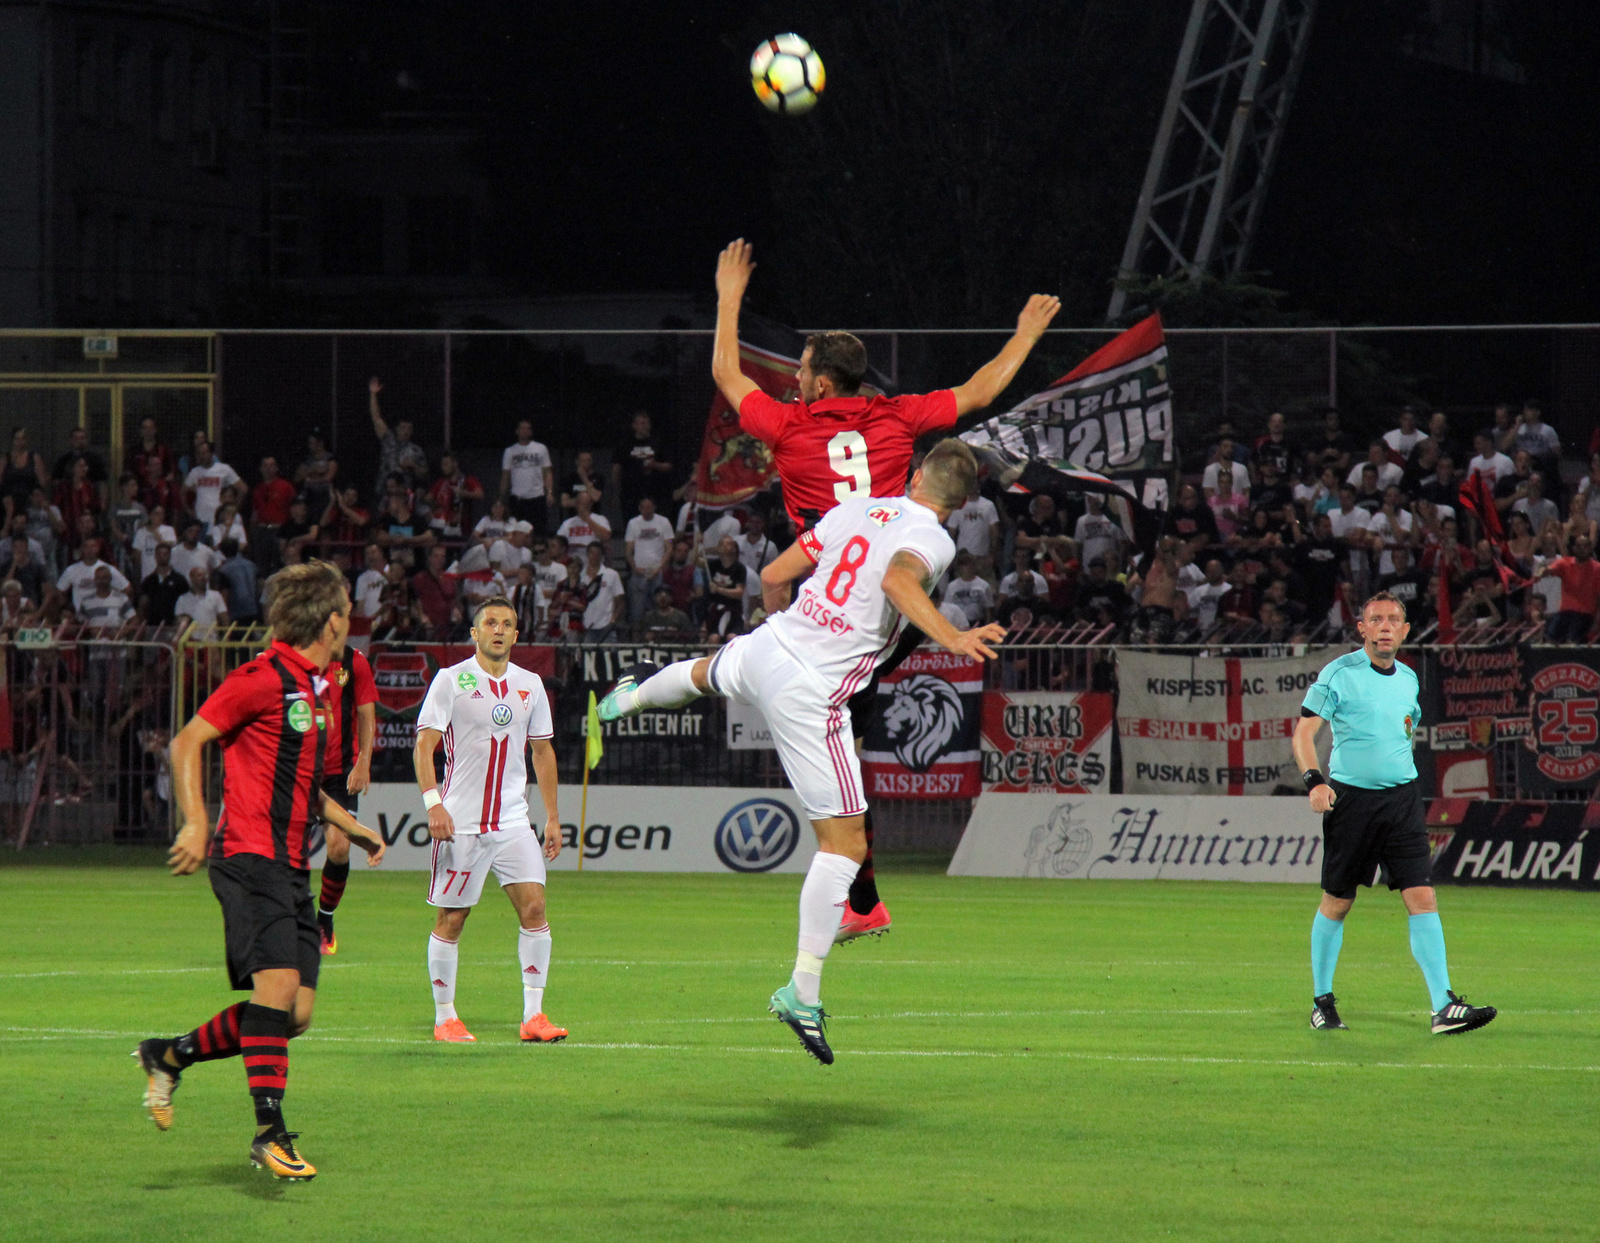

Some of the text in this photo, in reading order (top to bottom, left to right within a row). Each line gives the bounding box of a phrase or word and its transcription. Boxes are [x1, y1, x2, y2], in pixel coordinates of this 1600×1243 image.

[827, 430, 872, 503] 9
[826, 535, 870, 607] 8
[1147, 678, 1231, 697] KISPEST
[1119, 717, 1140, 736] WE
[1148, 722, 1209, 740] SHALL
[1216, 721, 1253, 741] NOT
[1260, 719, 1285, 737] BE
[1538, 697, 1599, 746] 25
[874, 773, 964, 793] KISPEST
[1136, 761, 1210, 783] PUSKÁS
[1453, 829, 1589, 880] HAJRÁ
[443, 868, 472, 897] 77
